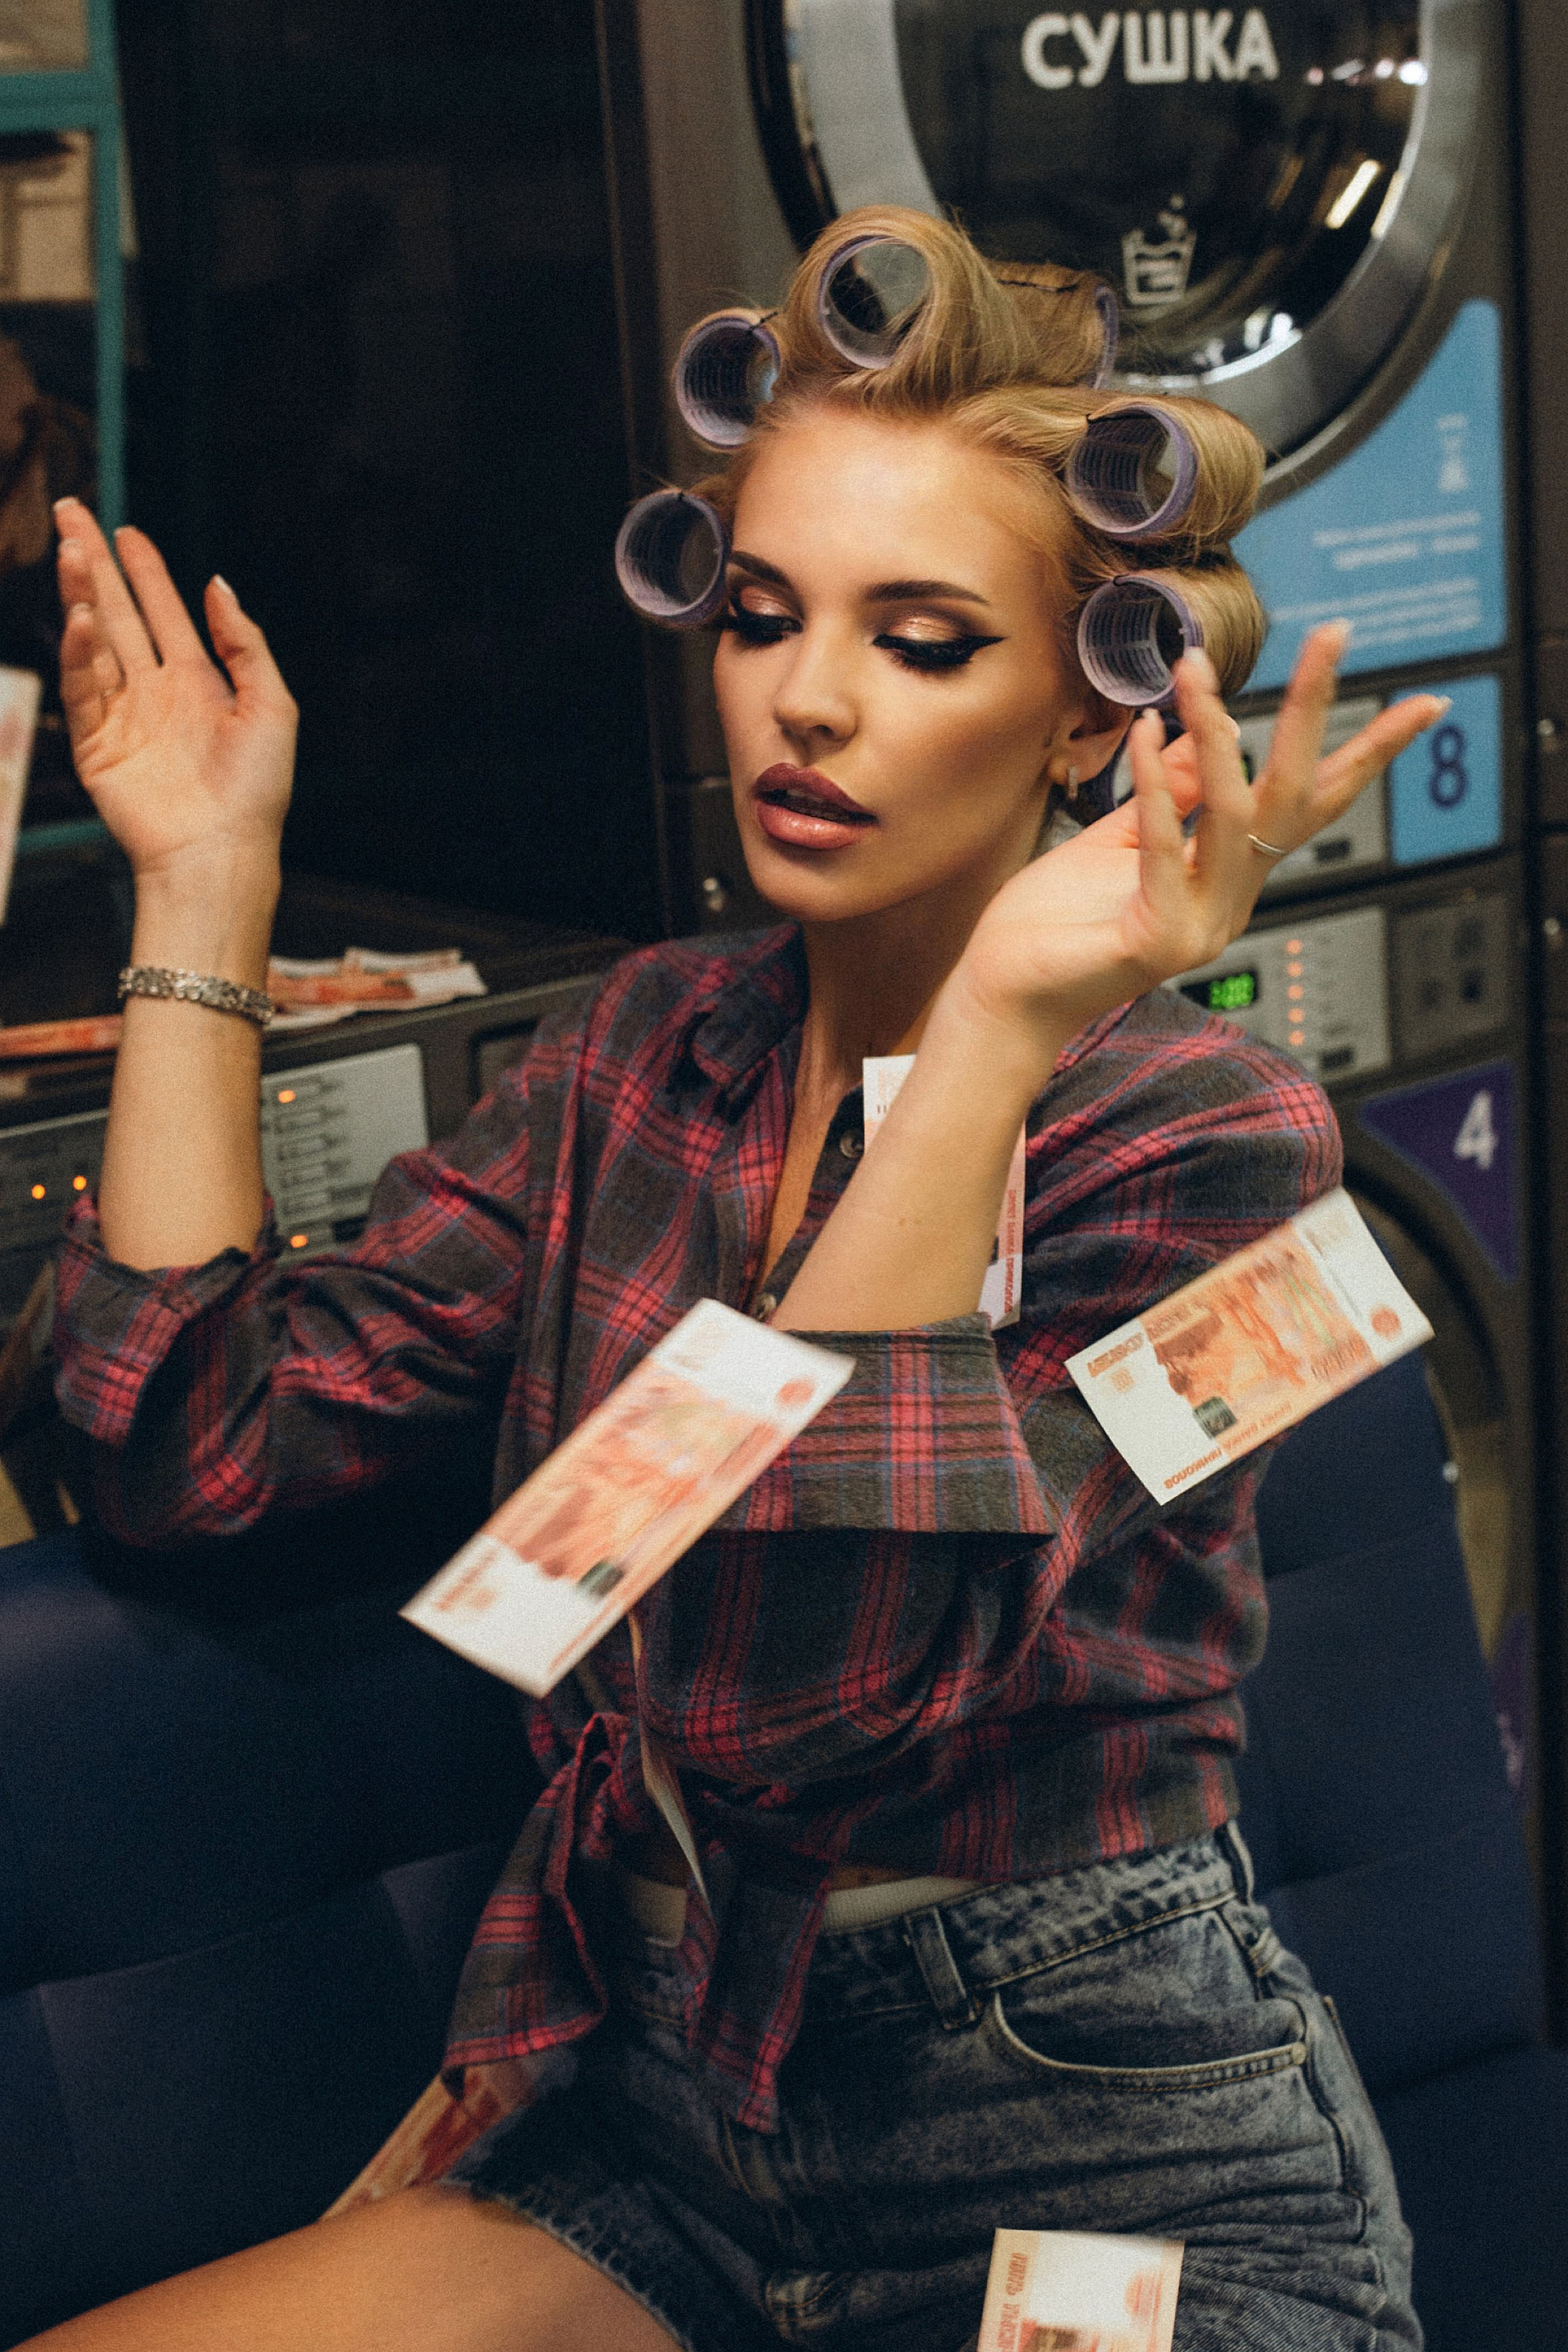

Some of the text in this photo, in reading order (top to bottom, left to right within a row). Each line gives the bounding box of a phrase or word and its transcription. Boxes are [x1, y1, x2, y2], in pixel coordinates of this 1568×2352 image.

[1021, 8, 1281, 90] СУШКА
[1428, 724, 1469, 810] 8
[1453, 1089, 1499, 1170] 4
